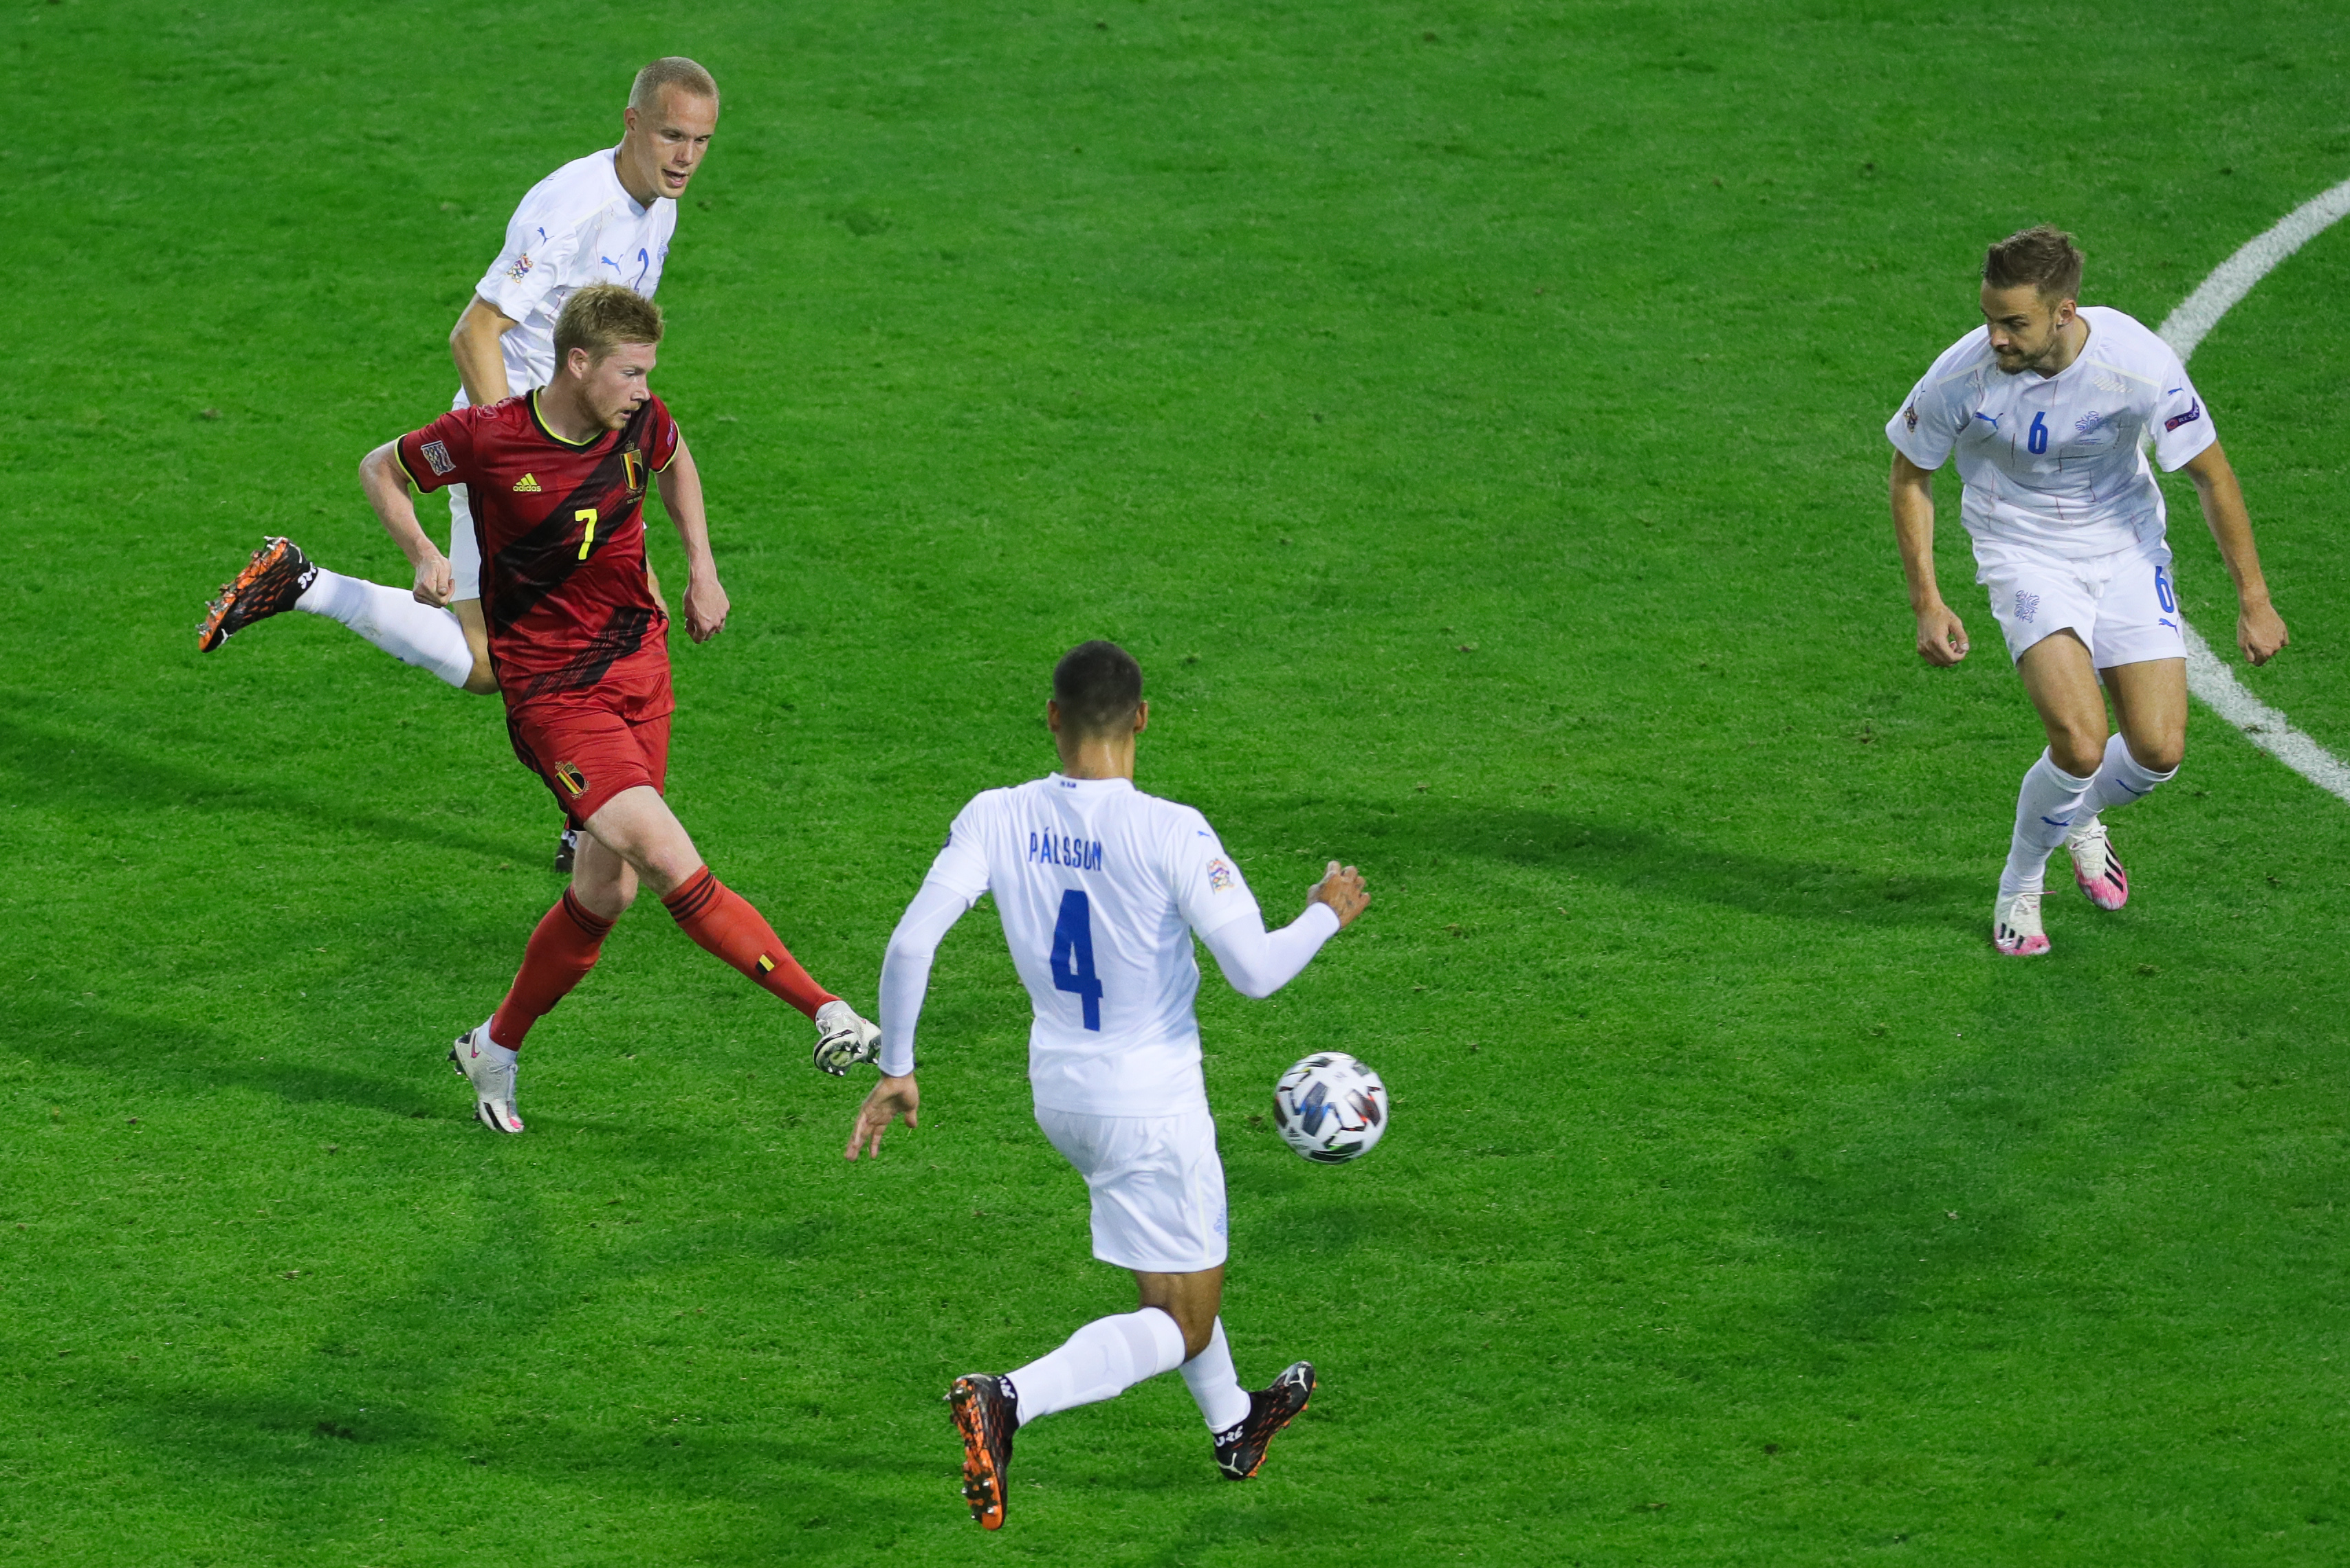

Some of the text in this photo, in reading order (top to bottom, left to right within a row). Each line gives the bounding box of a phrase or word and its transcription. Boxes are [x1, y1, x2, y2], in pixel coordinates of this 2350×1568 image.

[635, 248, 649, 294] 2
[2028, 411, 2048, 455] 6
[575, 508, 597, 560] 7
[2155, 566, 2175, 614] 6
[1029, 826, 1102, 872] PÁLSSON
[1049, 889, 1103, 1033] 4
